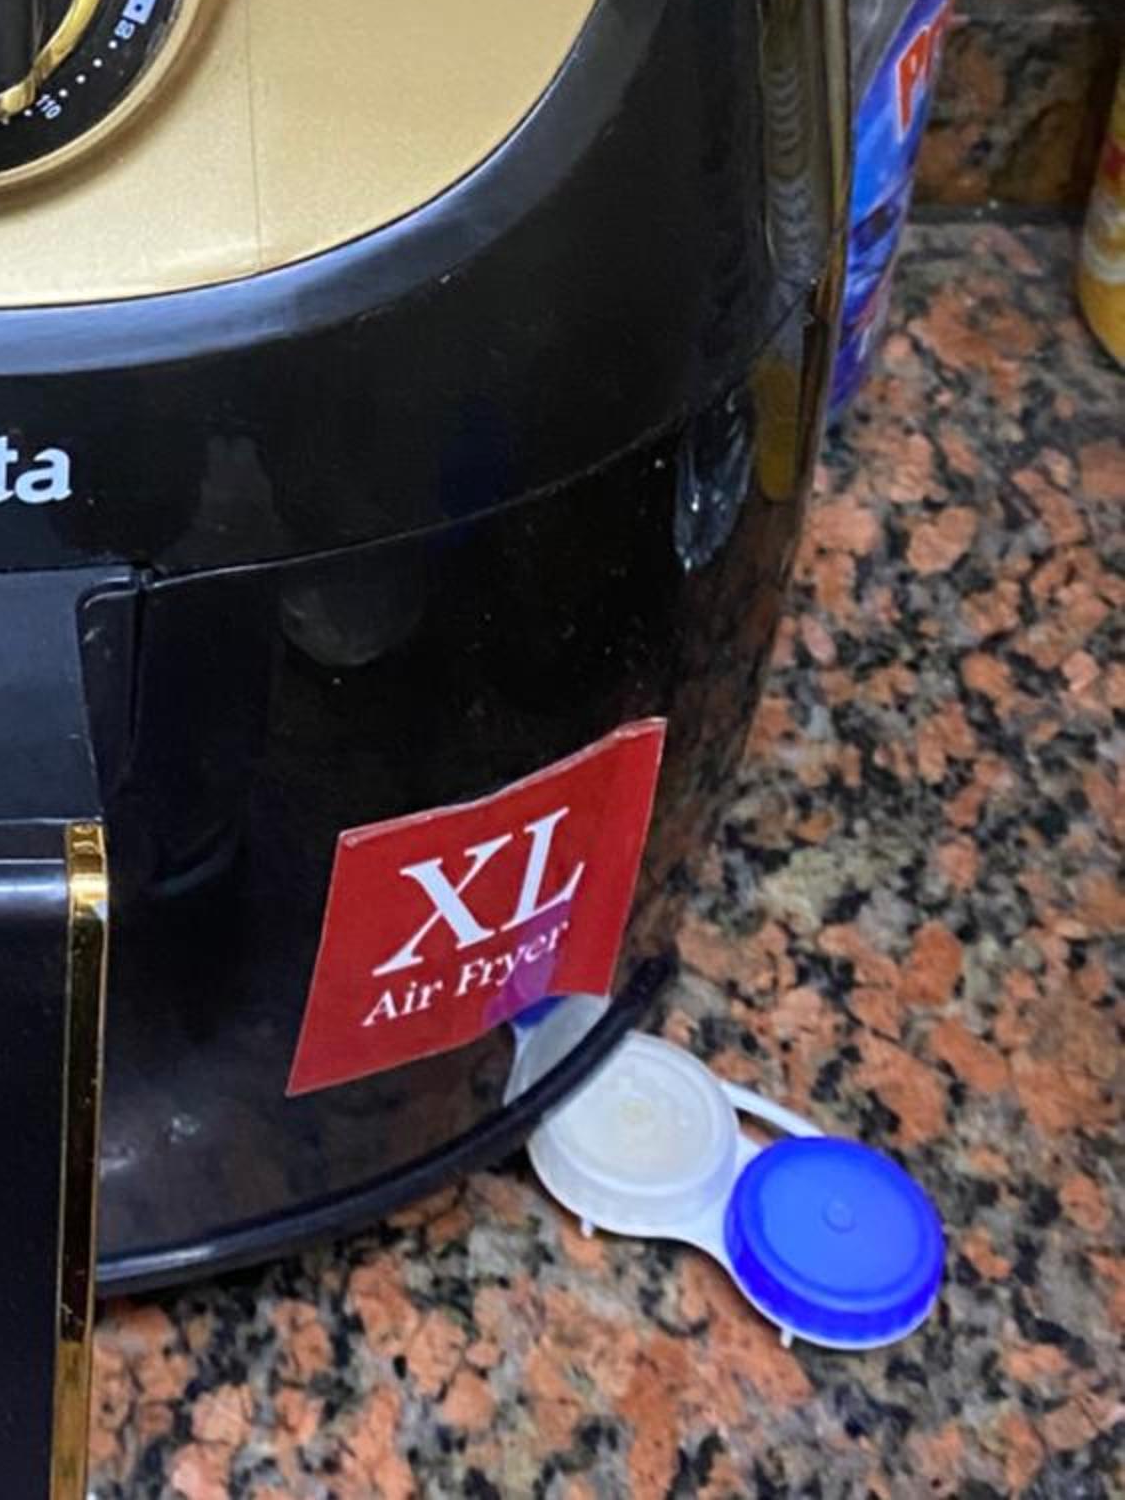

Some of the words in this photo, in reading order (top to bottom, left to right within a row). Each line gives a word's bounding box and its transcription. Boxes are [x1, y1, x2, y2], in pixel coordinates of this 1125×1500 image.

[371, 805, 585, 977] XL
[361, 980, 443, 1028] Air
[455, 920, 569, 998] Fryer
